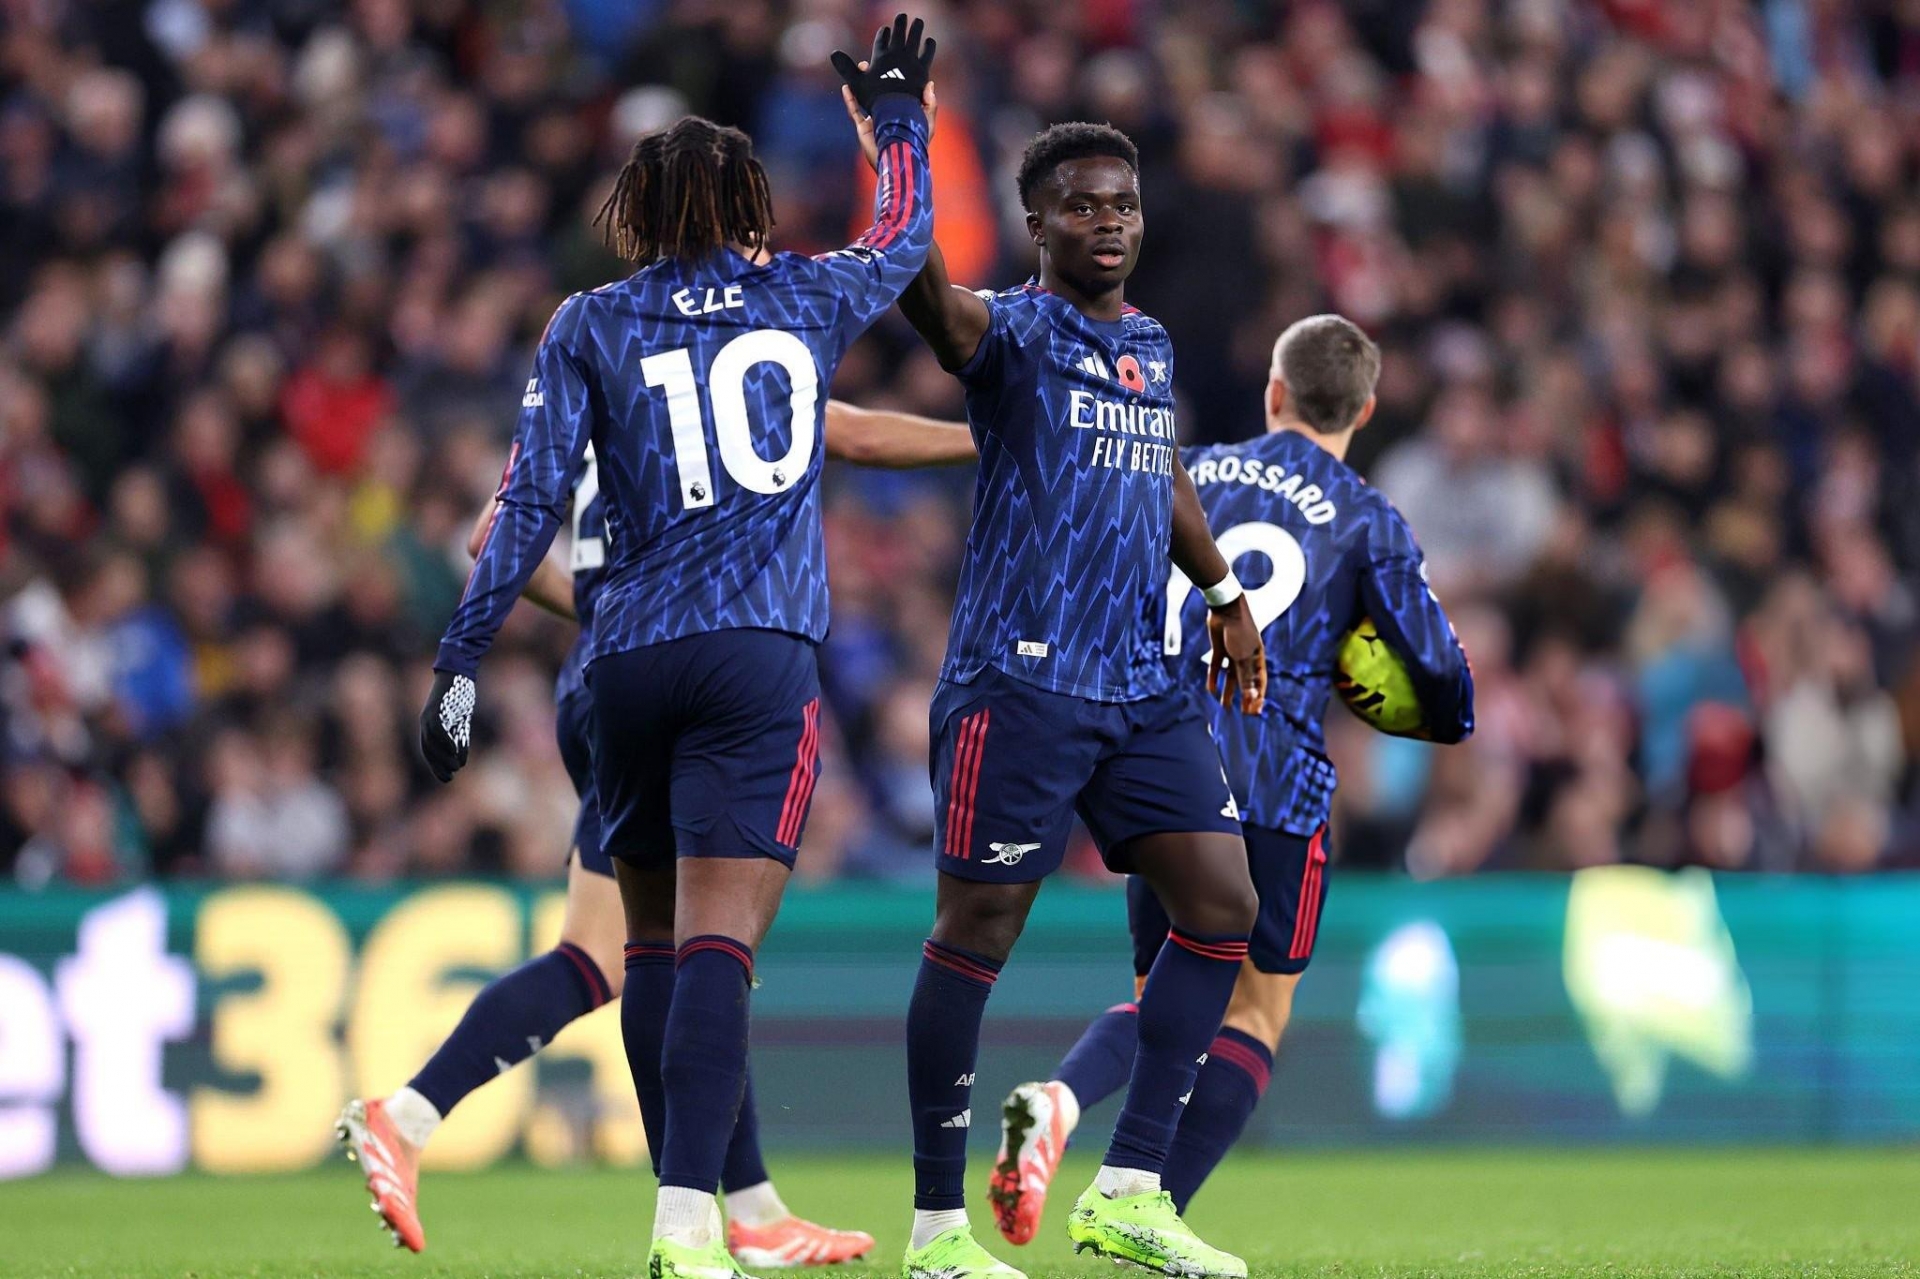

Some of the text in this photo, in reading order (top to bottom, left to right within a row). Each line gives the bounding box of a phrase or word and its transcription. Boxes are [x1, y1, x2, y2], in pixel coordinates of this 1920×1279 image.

[671, 285, 744, 316] EZE
[640, 329, 818, 510] 10
[1092, 437, 1126, 468] FLY
[571, 438, 613, 572] 2
